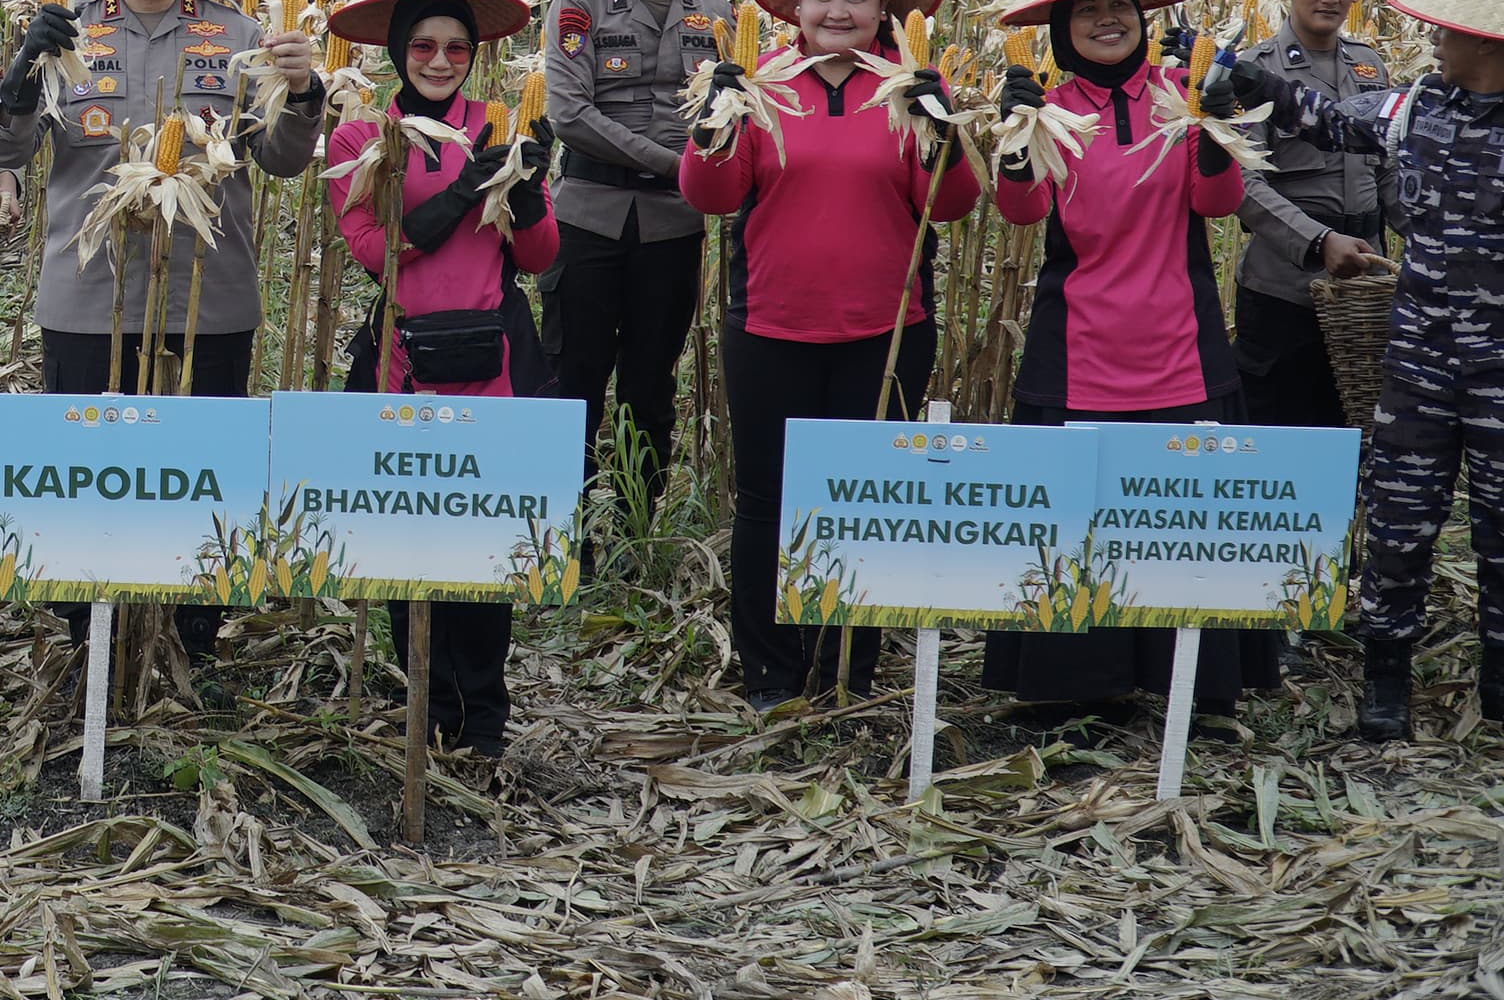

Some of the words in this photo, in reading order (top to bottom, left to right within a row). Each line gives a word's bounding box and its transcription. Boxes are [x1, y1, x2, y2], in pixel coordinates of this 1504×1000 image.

[184, 58, 229, 70] POLR
[374, 451, 481, 479] KETUA
[4, 464, 223, 502] KAPOLDA
[826, 478, 932, 505] WAKIL
[944, 482, 1051, 509] KETUA
[1120, 476, 1204, 499] WAKIL
[1213, 478, 1297, 501] KETUA
[304, 488, 548, 520] BHAYANGKARI
[815, 516, 1058, 547] BHAYANGKARI
[1217, 510, 1323, 533] KEMALA
[1107, 540, 1297, 564] BHAYANGKARI
